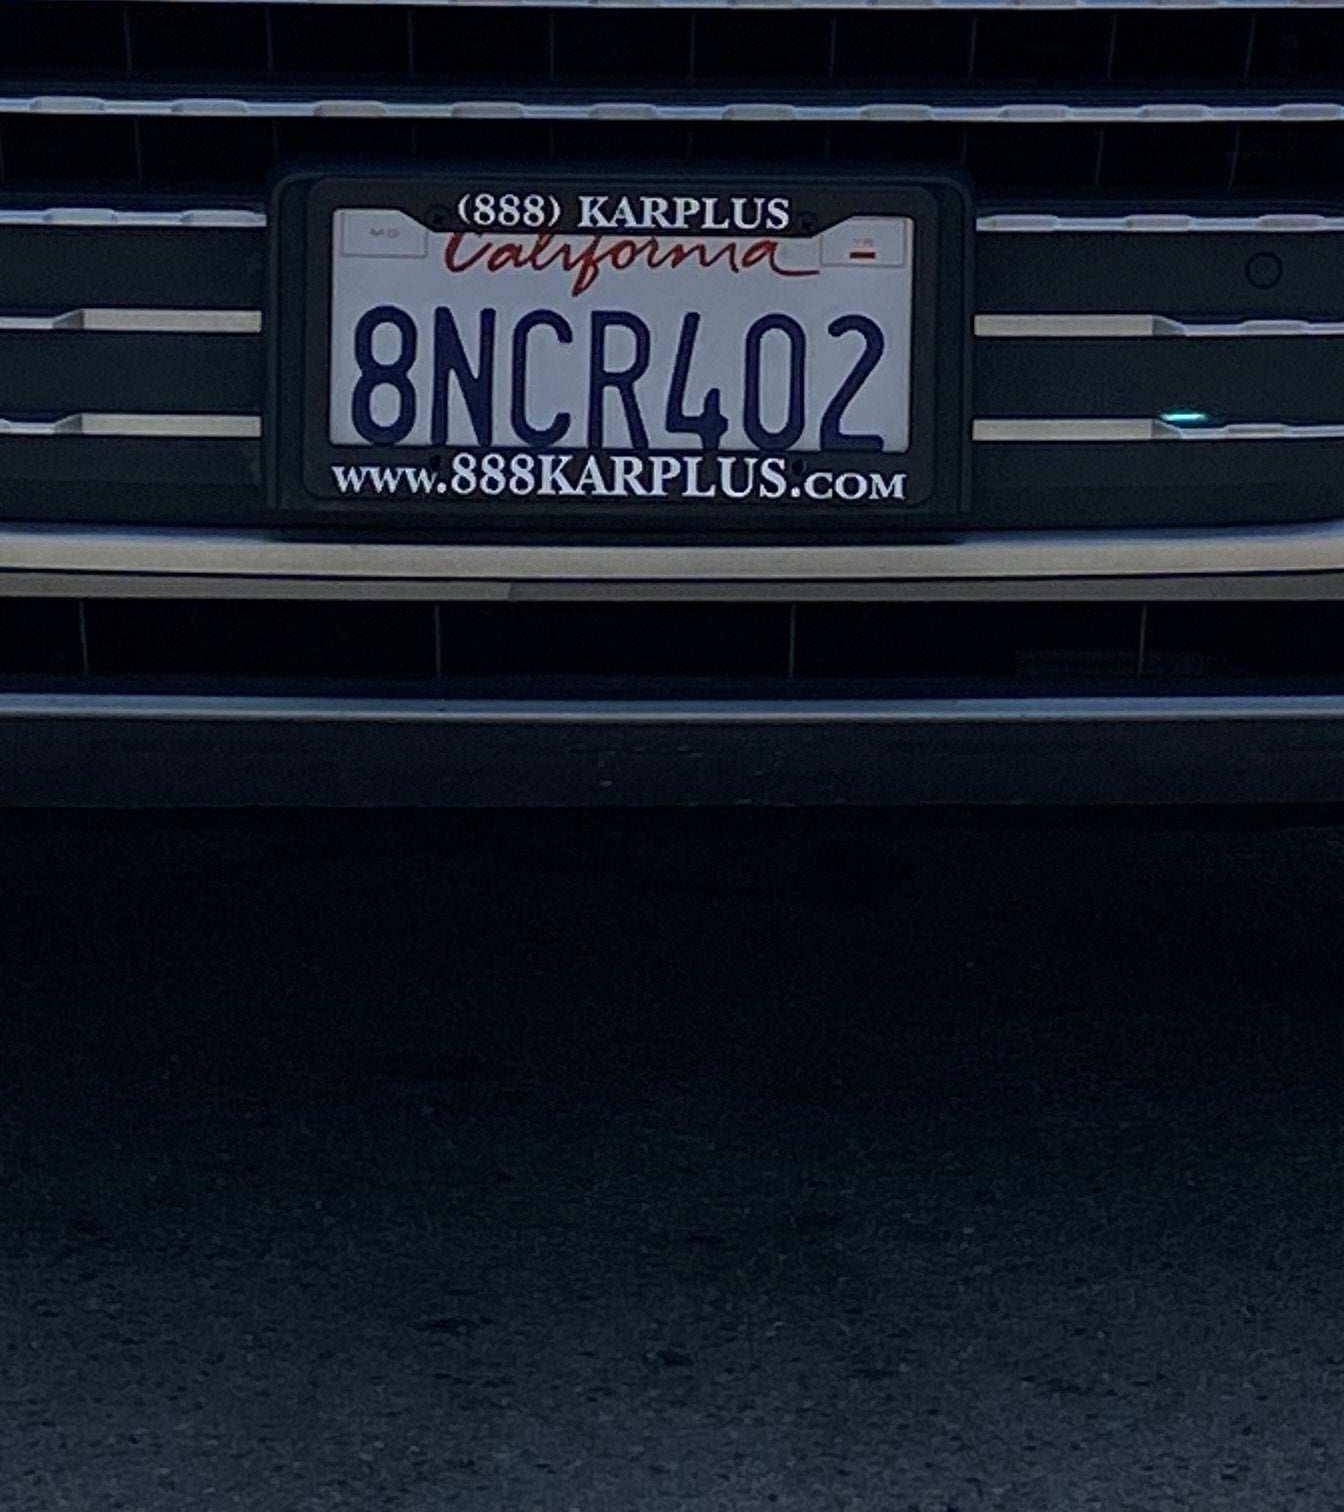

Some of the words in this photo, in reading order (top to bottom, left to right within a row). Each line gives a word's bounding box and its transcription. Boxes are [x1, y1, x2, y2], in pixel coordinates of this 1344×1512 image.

[457, 192, 562, 230] (888)
[577, 195, 791, 231] KARPLUS
[444, 231, 821, 297] California
[351, 305, 887, 451] 8NCR402
